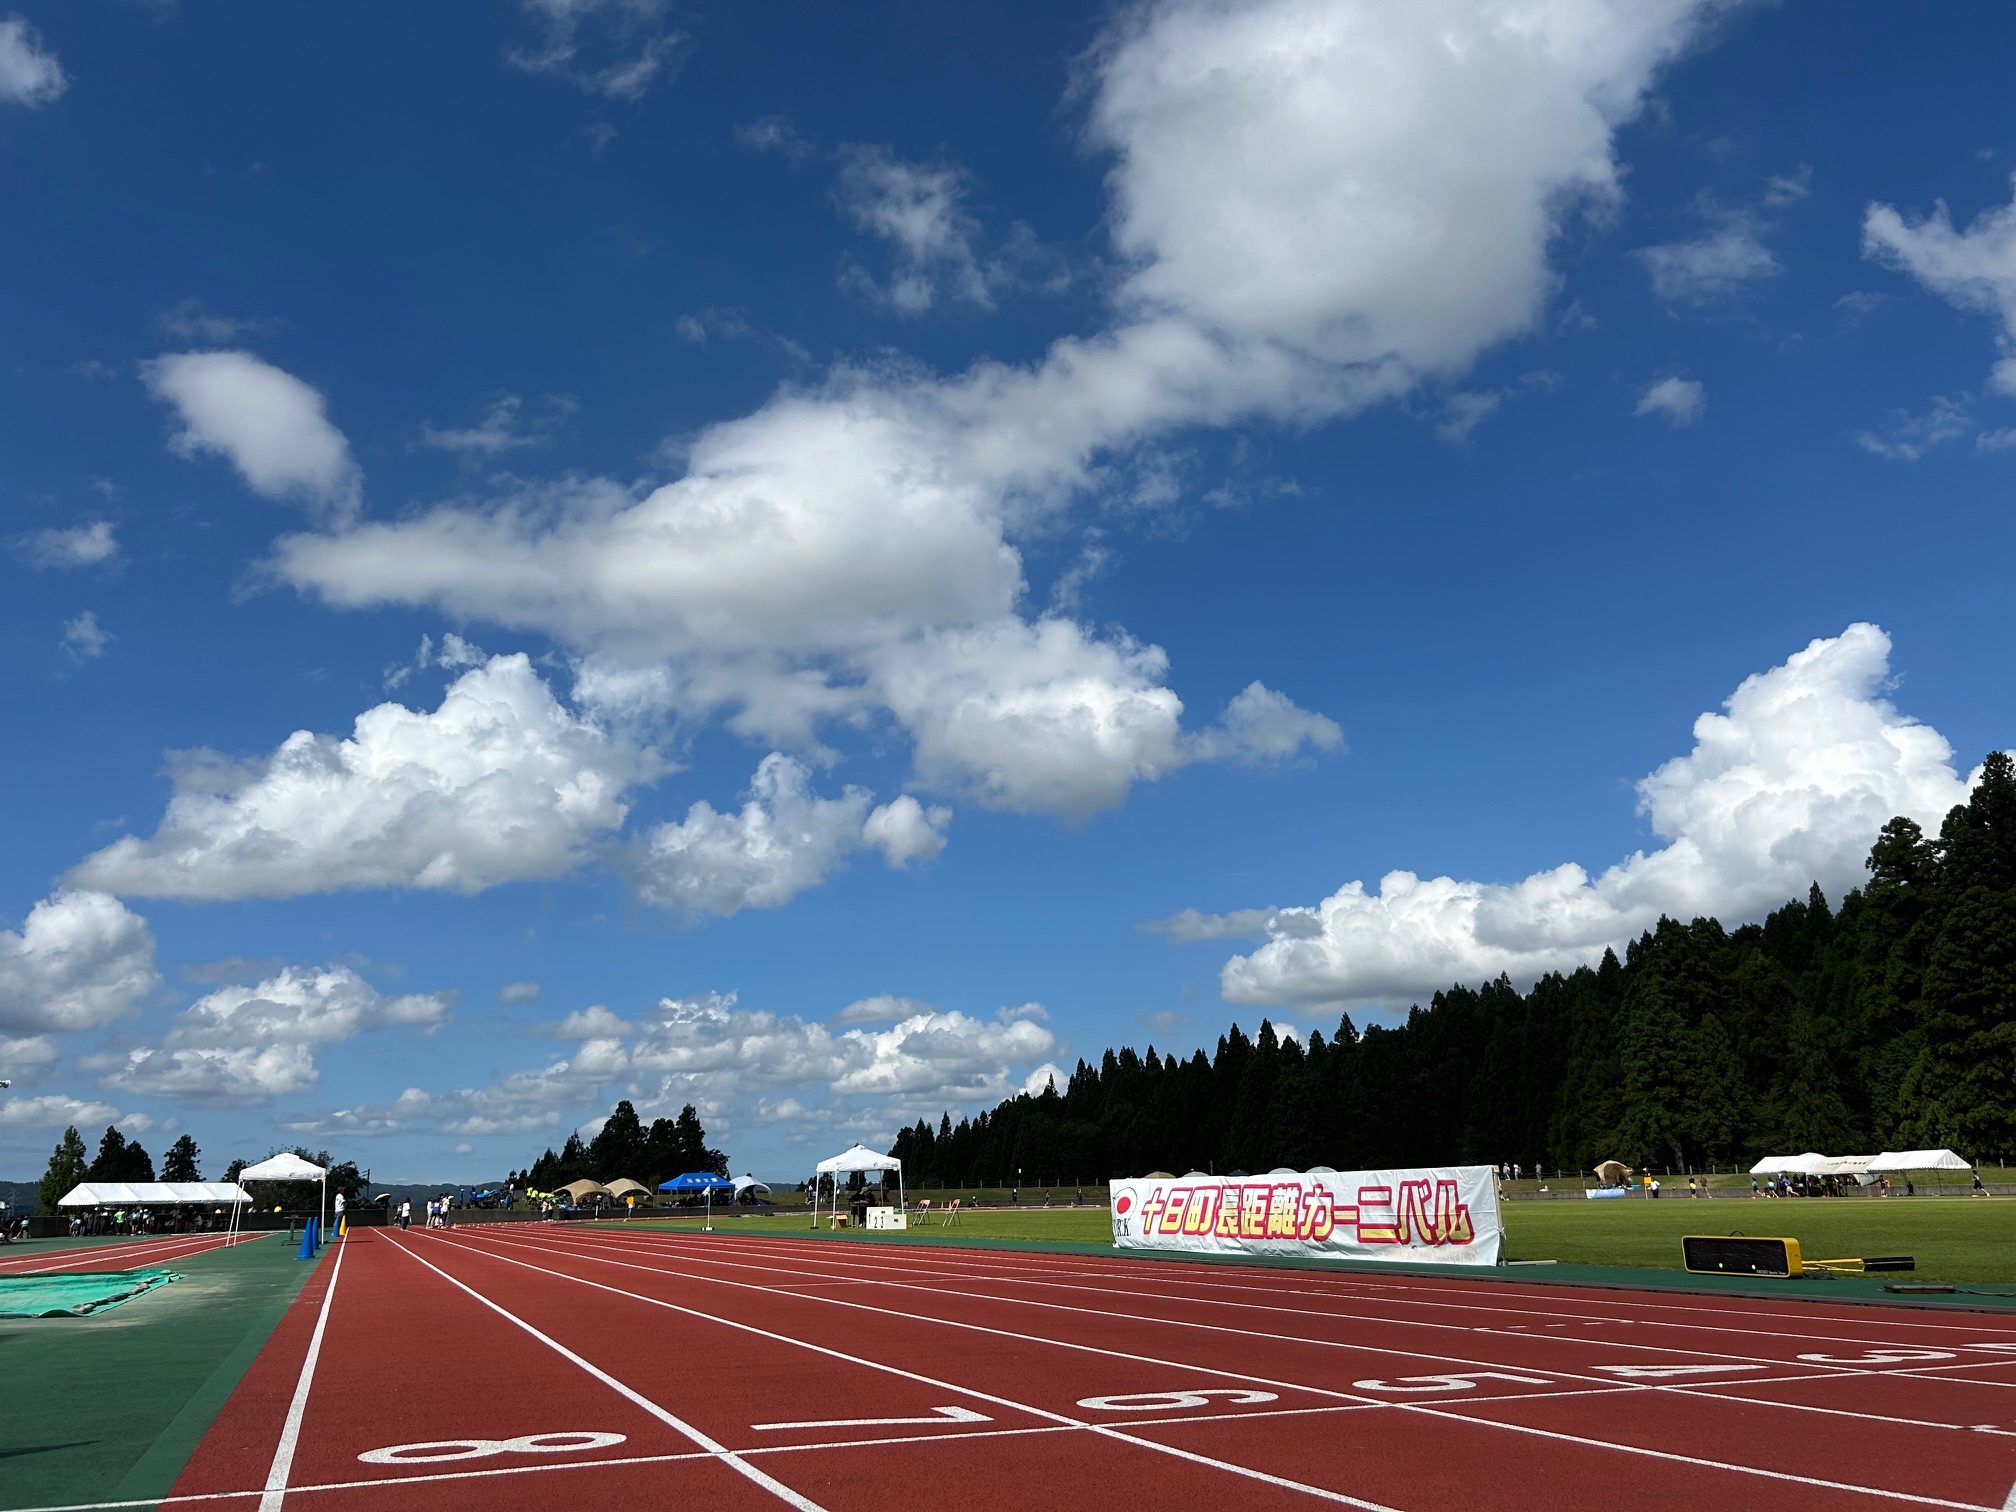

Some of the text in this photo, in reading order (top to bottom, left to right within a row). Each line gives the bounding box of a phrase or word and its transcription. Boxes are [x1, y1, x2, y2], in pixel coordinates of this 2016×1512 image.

[1141, 1178, 1475, 1246] 十日町長距離カーニバル
[357, 1349, 1958, 1465] 8 7 6 5 4 3
